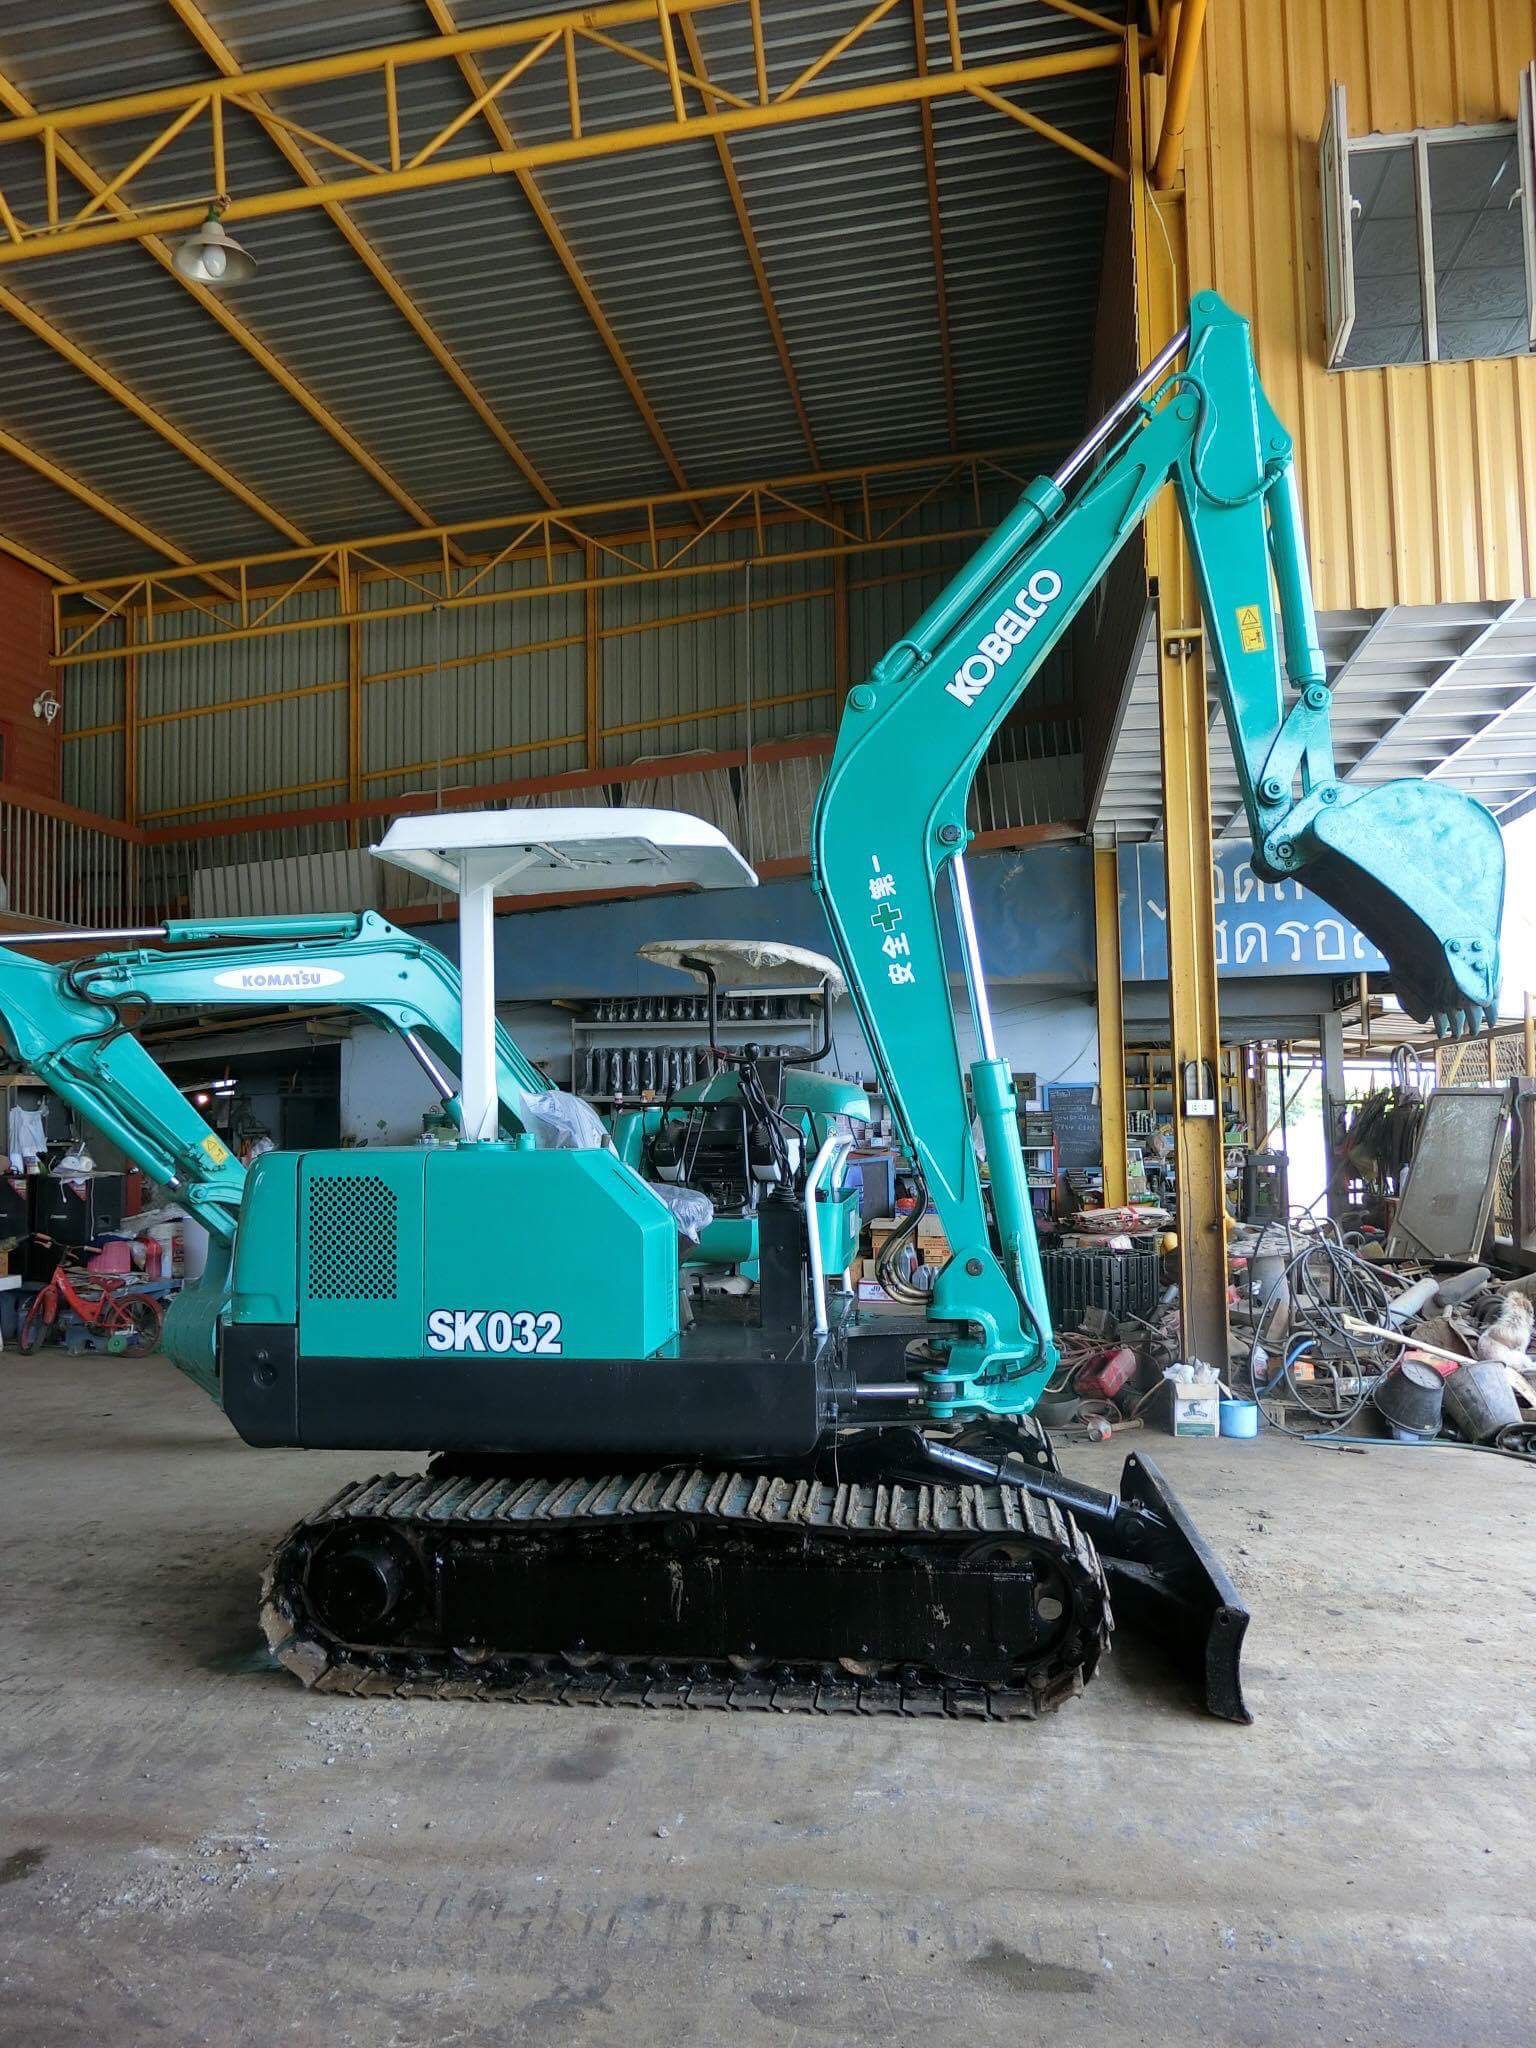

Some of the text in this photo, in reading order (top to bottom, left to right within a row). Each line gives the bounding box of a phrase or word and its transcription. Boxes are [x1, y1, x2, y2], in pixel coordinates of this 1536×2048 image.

[944, 569, 1062, 708] KOBELCO
[242, 970, 321, 987] KOMATSU
[426, 1308, 563, 1355] SK032
